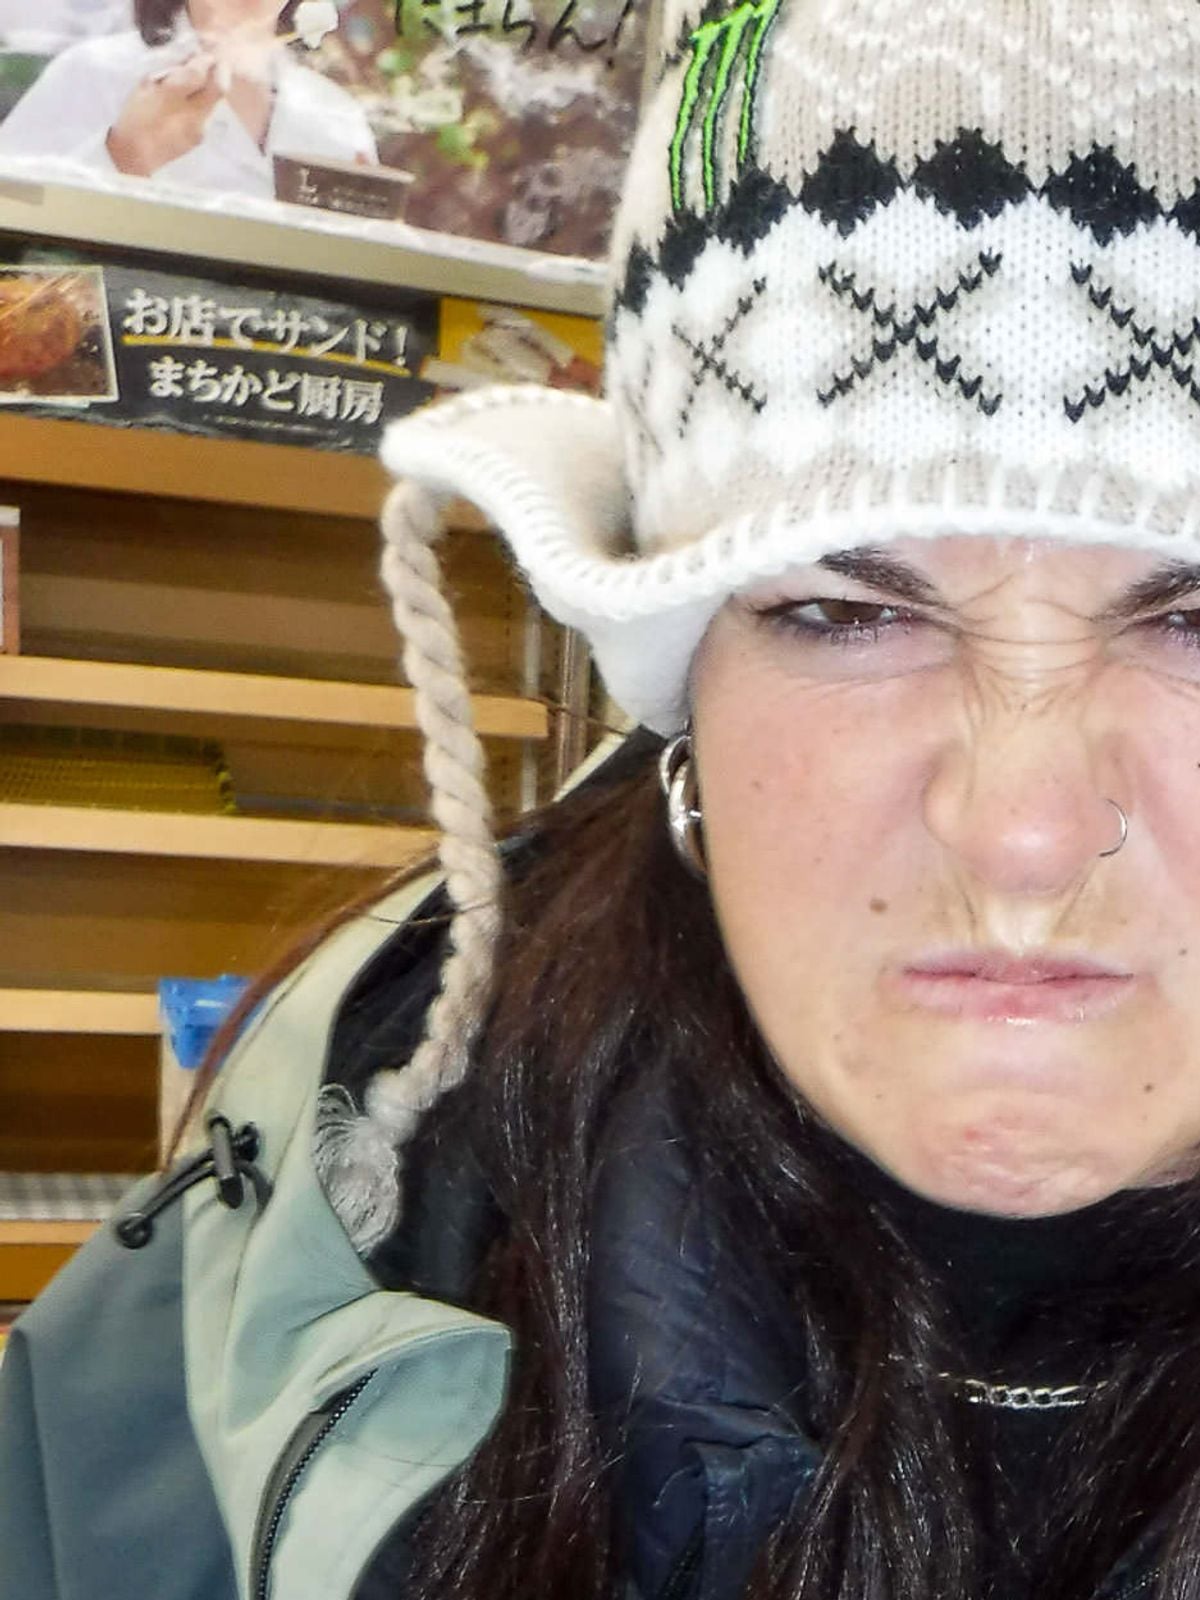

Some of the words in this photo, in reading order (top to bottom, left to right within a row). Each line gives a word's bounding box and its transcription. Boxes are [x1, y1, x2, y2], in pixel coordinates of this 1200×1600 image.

[122, 287, 407, 367] お店でサンド!
[149, 355, 384, 425] まちかど厨房
